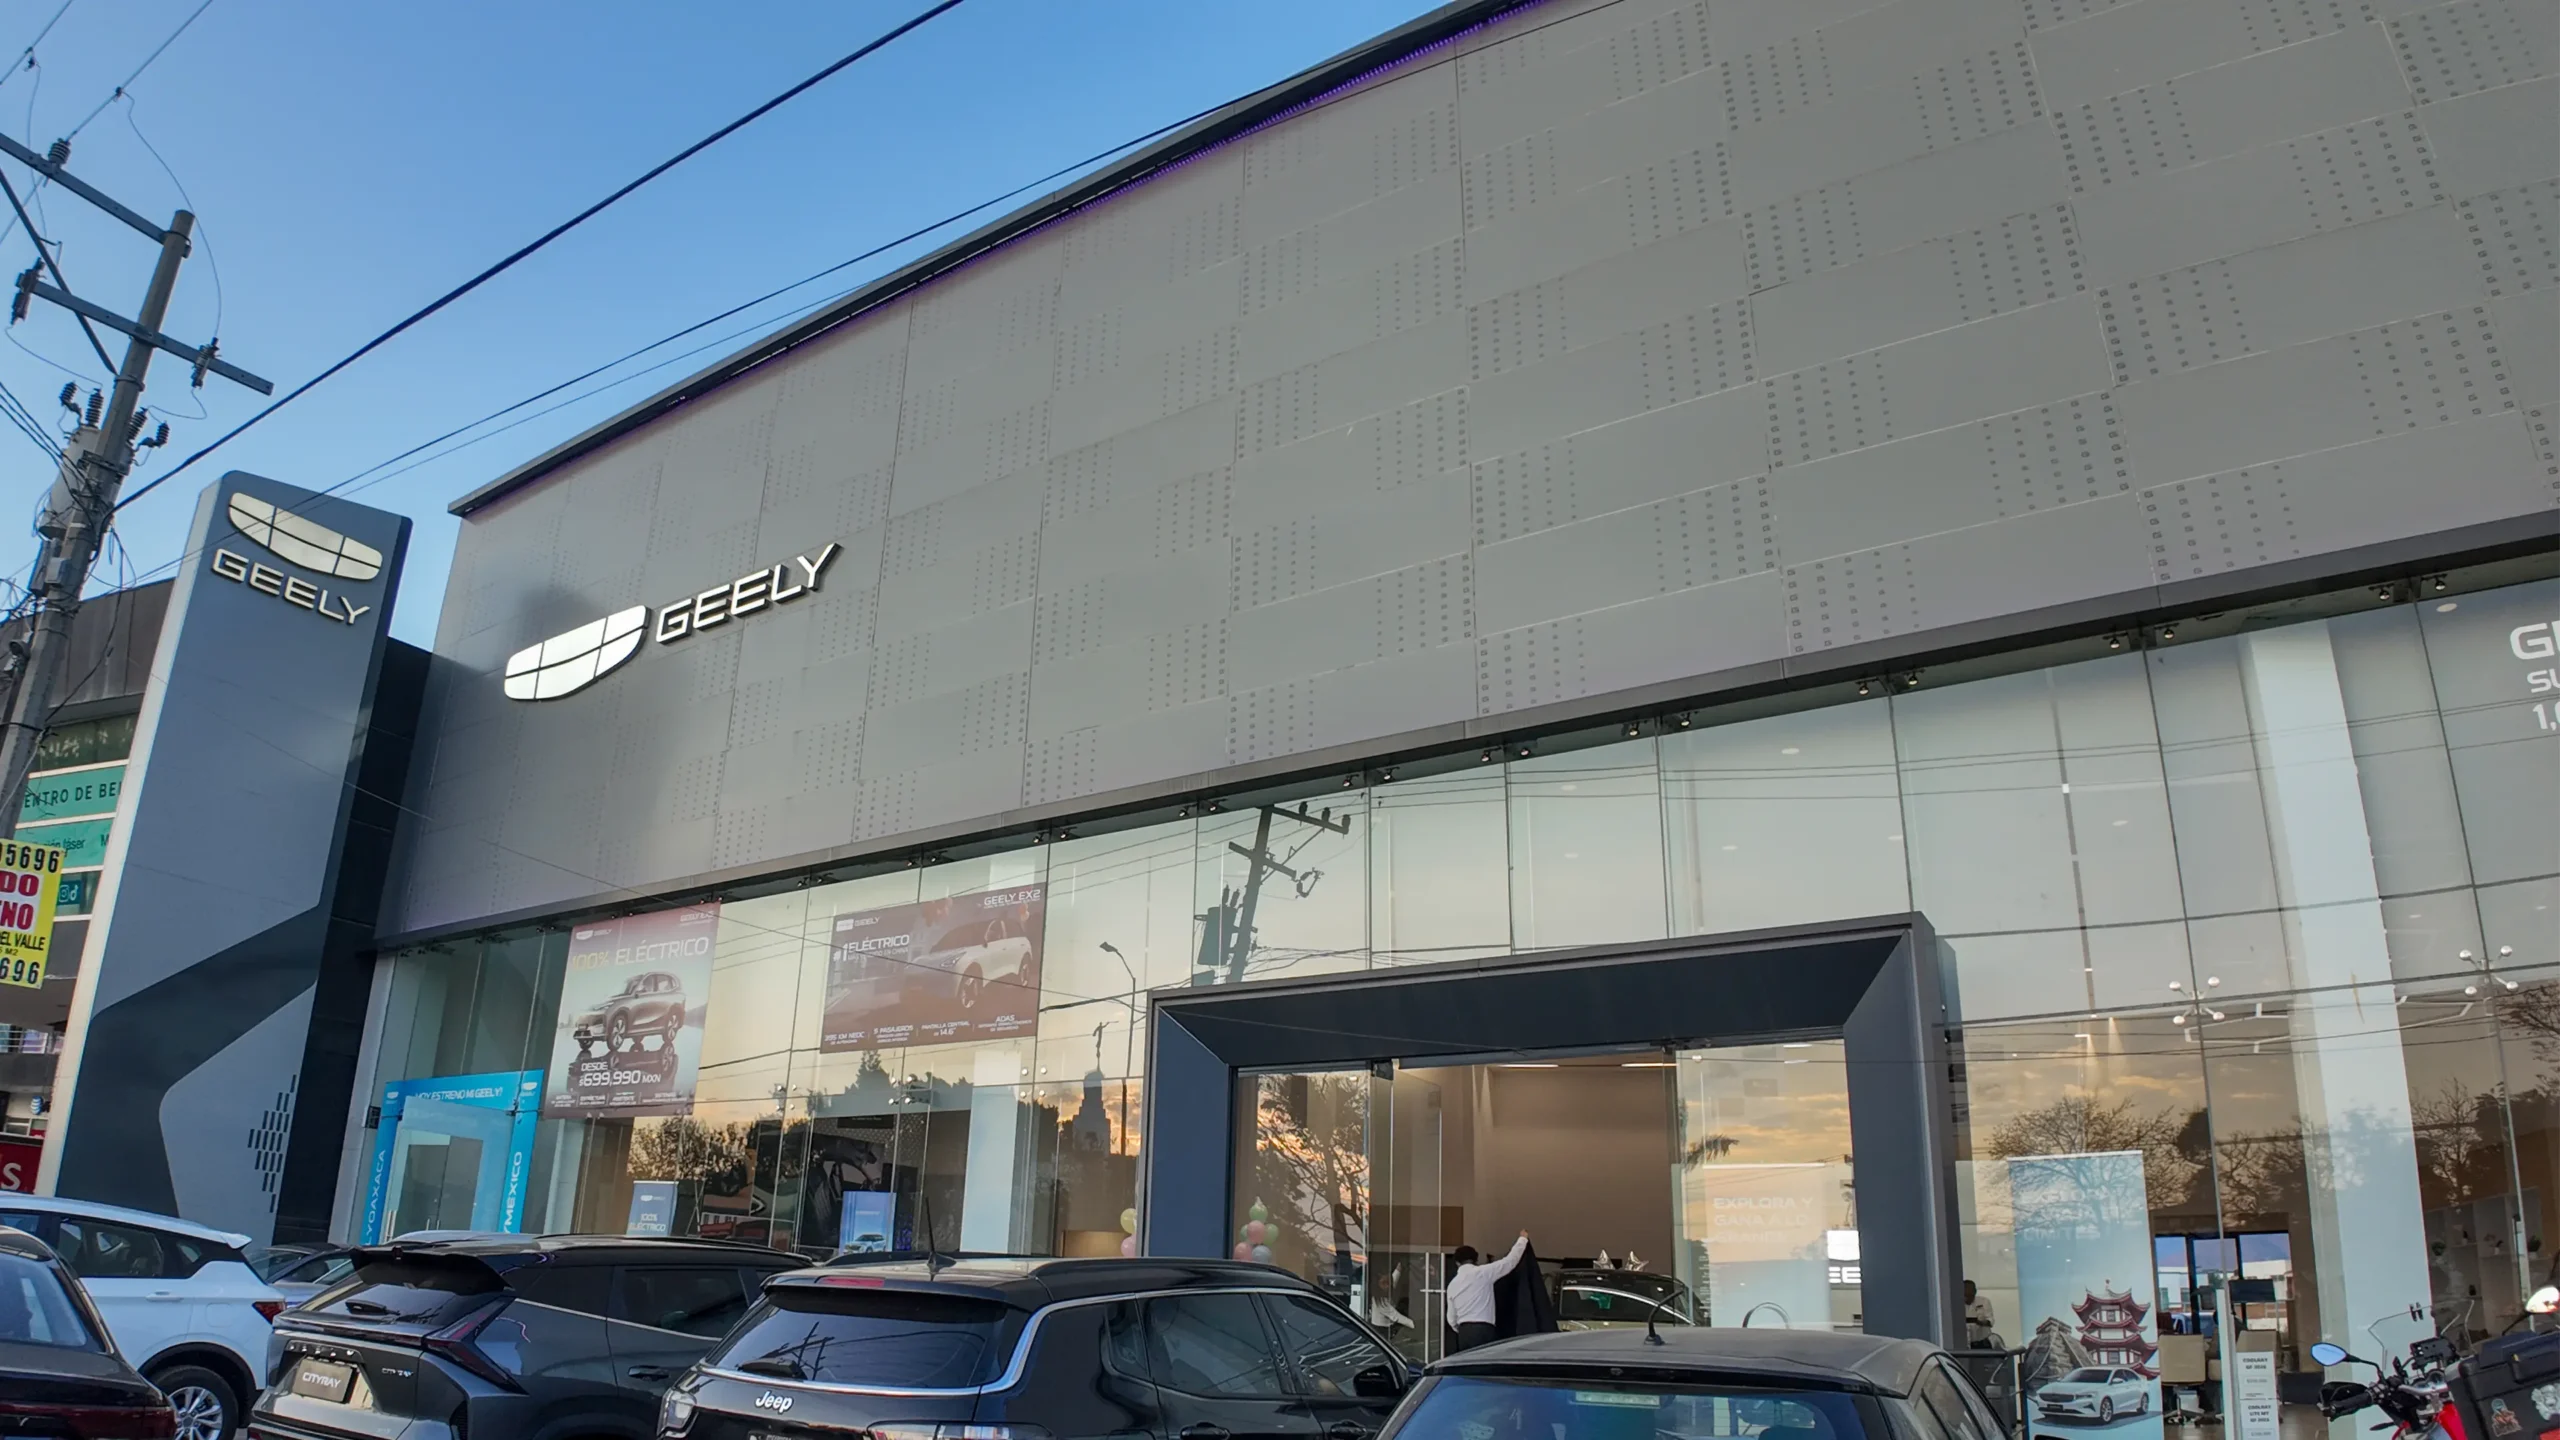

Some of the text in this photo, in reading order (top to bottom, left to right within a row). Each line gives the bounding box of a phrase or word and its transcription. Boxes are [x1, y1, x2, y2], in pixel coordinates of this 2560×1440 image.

[212, 548, 370, 625] GEELY
[656, 542, 842, 645] GEELY
[2510, 620, 2560, 660] G
[75, 785, 93, 802] DE
[984, 889, 1041, 906] GEELY EX2
[0, 900, 34, 930] NO
[15, 932, 46, 951] VALLE
[572, 937, 710, 971] 100% ELÉCTRICO
[0, 957, 41, 984] 696
[996, 1014, 1015, 1022] ADAS
[581, 1061, 609, 1071] DESDE
[579, 1070, 662, 1087] $699,990 MXN
[367, 1150, 387, 1224] OAXACA
[1713, 1197, 1797, 1210] EXPLORA
[302, 1371, 342, 1389] CITYRAY
[755, 1390, 794, 1414] Jeep
